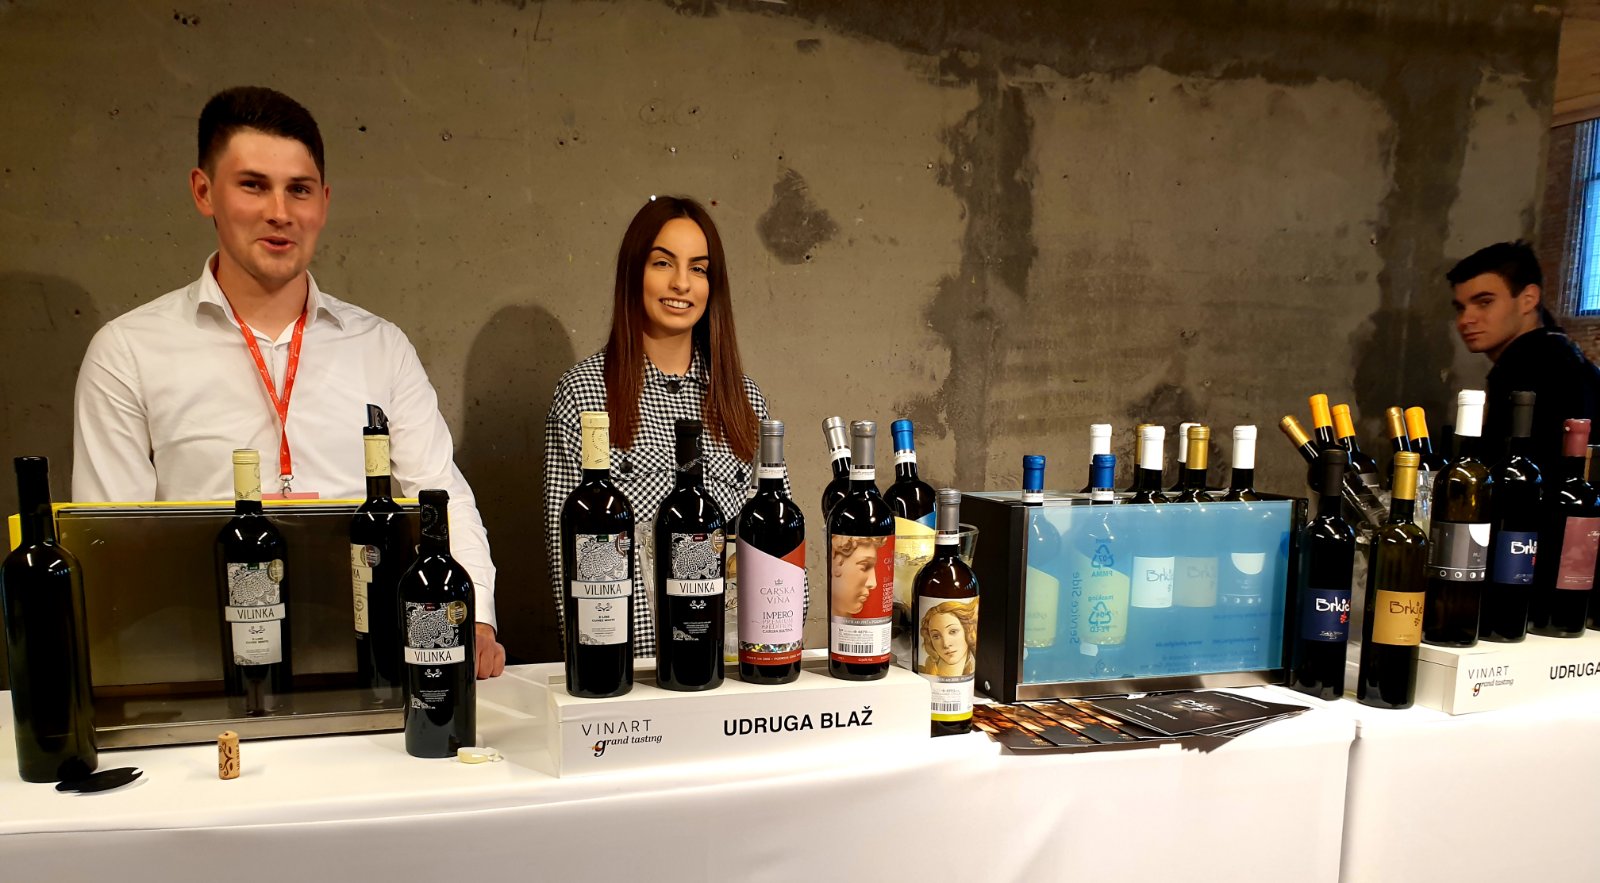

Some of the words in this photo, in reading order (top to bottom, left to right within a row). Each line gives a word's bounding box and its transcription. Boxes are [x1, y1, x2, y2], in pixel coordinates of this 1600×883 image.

[1510, 538, 1538, 555] Brki
[584, 583, 622, 596] VILINKA
[680, 582, 715, 594] VILINKA
[760, 586, 795, 596] CARSKA
[237, 607, 275, 619] VILINKA
[762, 609, 794, 619] IMPERO
[414, 650, 452, 662] VILINKA
[1468, 665, 1509, 680] VINART
[1472, 679, 1494, 698] grand
[1495, 678, 1514, 686] tasting
[581, 718, 652, 736] VINART
[723, 713, 814, 737] UDRUGA
[820, 705, 873, 729] BLAŽ
[593, 735, 629, 758] grand
[631, 733, 663, 745] tasting
